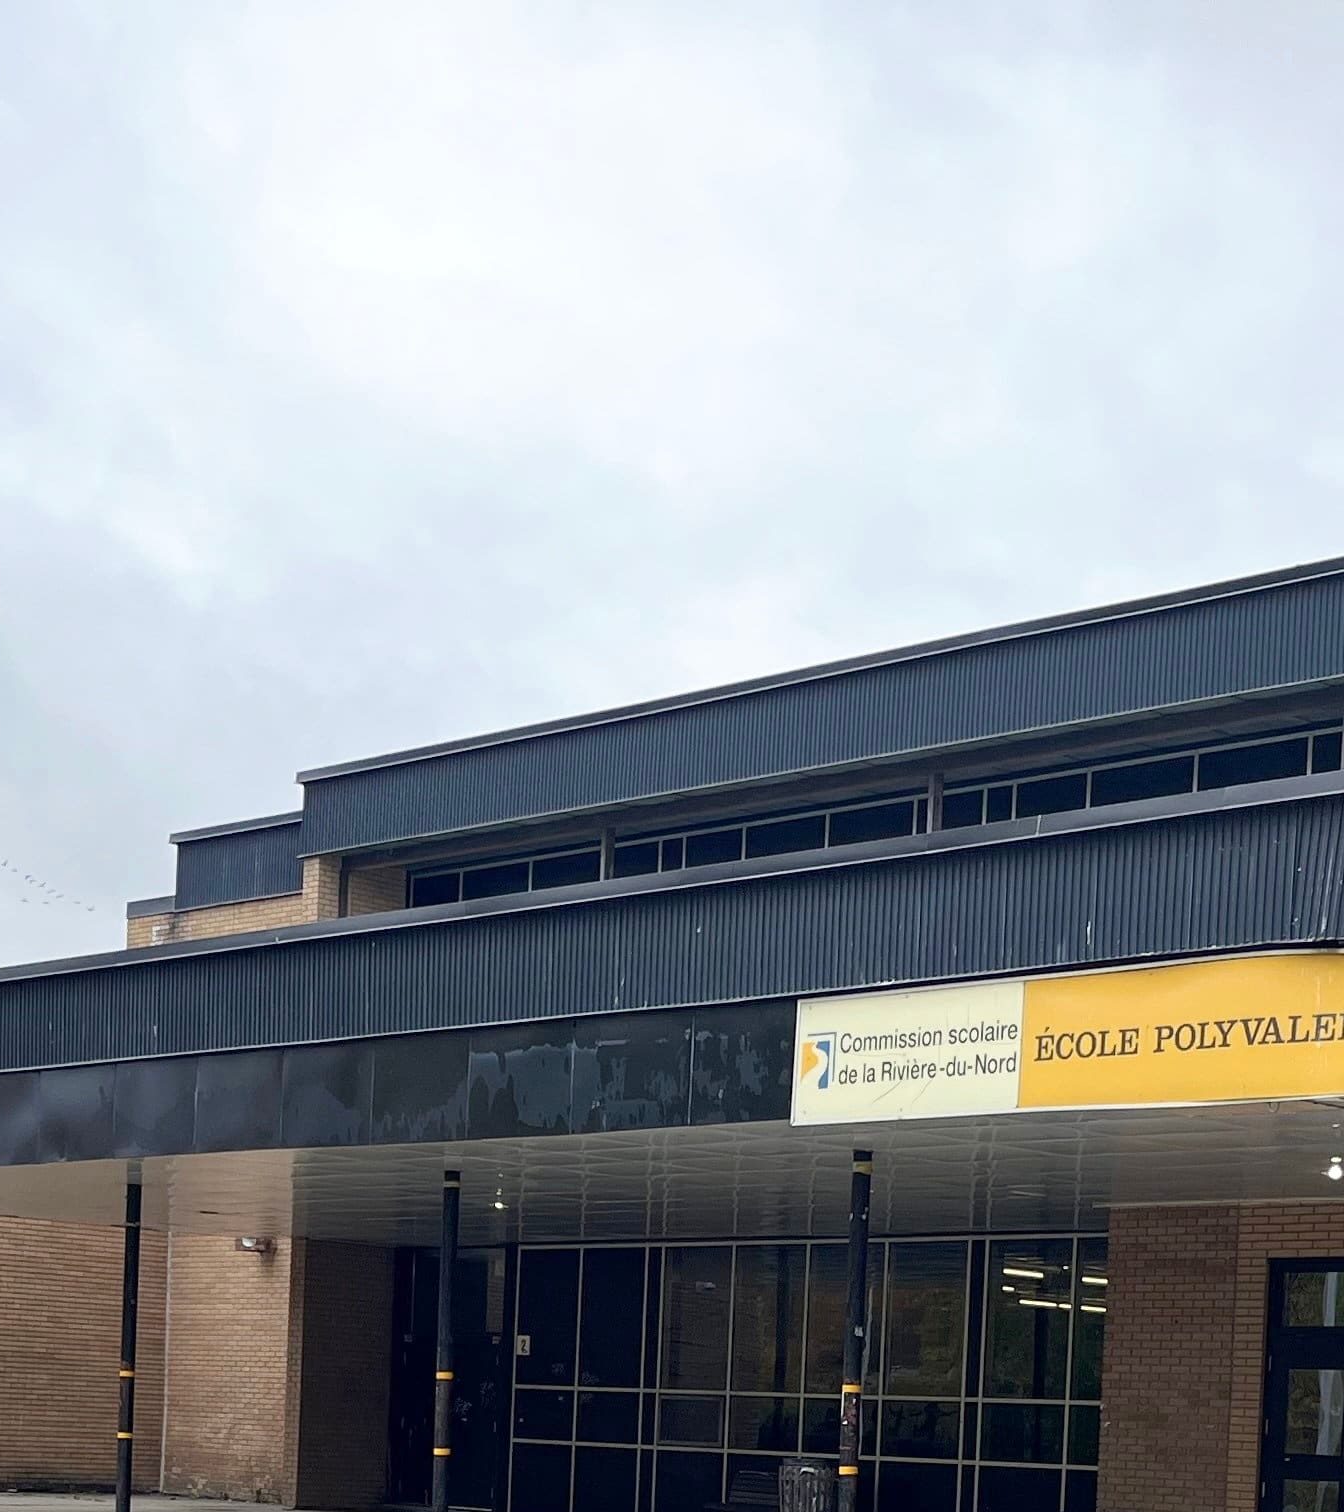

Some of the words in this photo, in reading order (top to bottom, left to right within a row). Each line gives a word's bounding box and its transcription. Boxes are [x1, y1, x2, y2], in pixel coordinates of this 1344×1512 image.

[839, 1026, 943, 1054] Commission
[948, 1020, 1019, 1045] scolaire
[1033, 1026, 1140, 1062] ÉCOLE
[838, 1064, 858, 1085] de
[862, 1063, 877, 1084] la
[521, 1338, 529, 1353] 2
